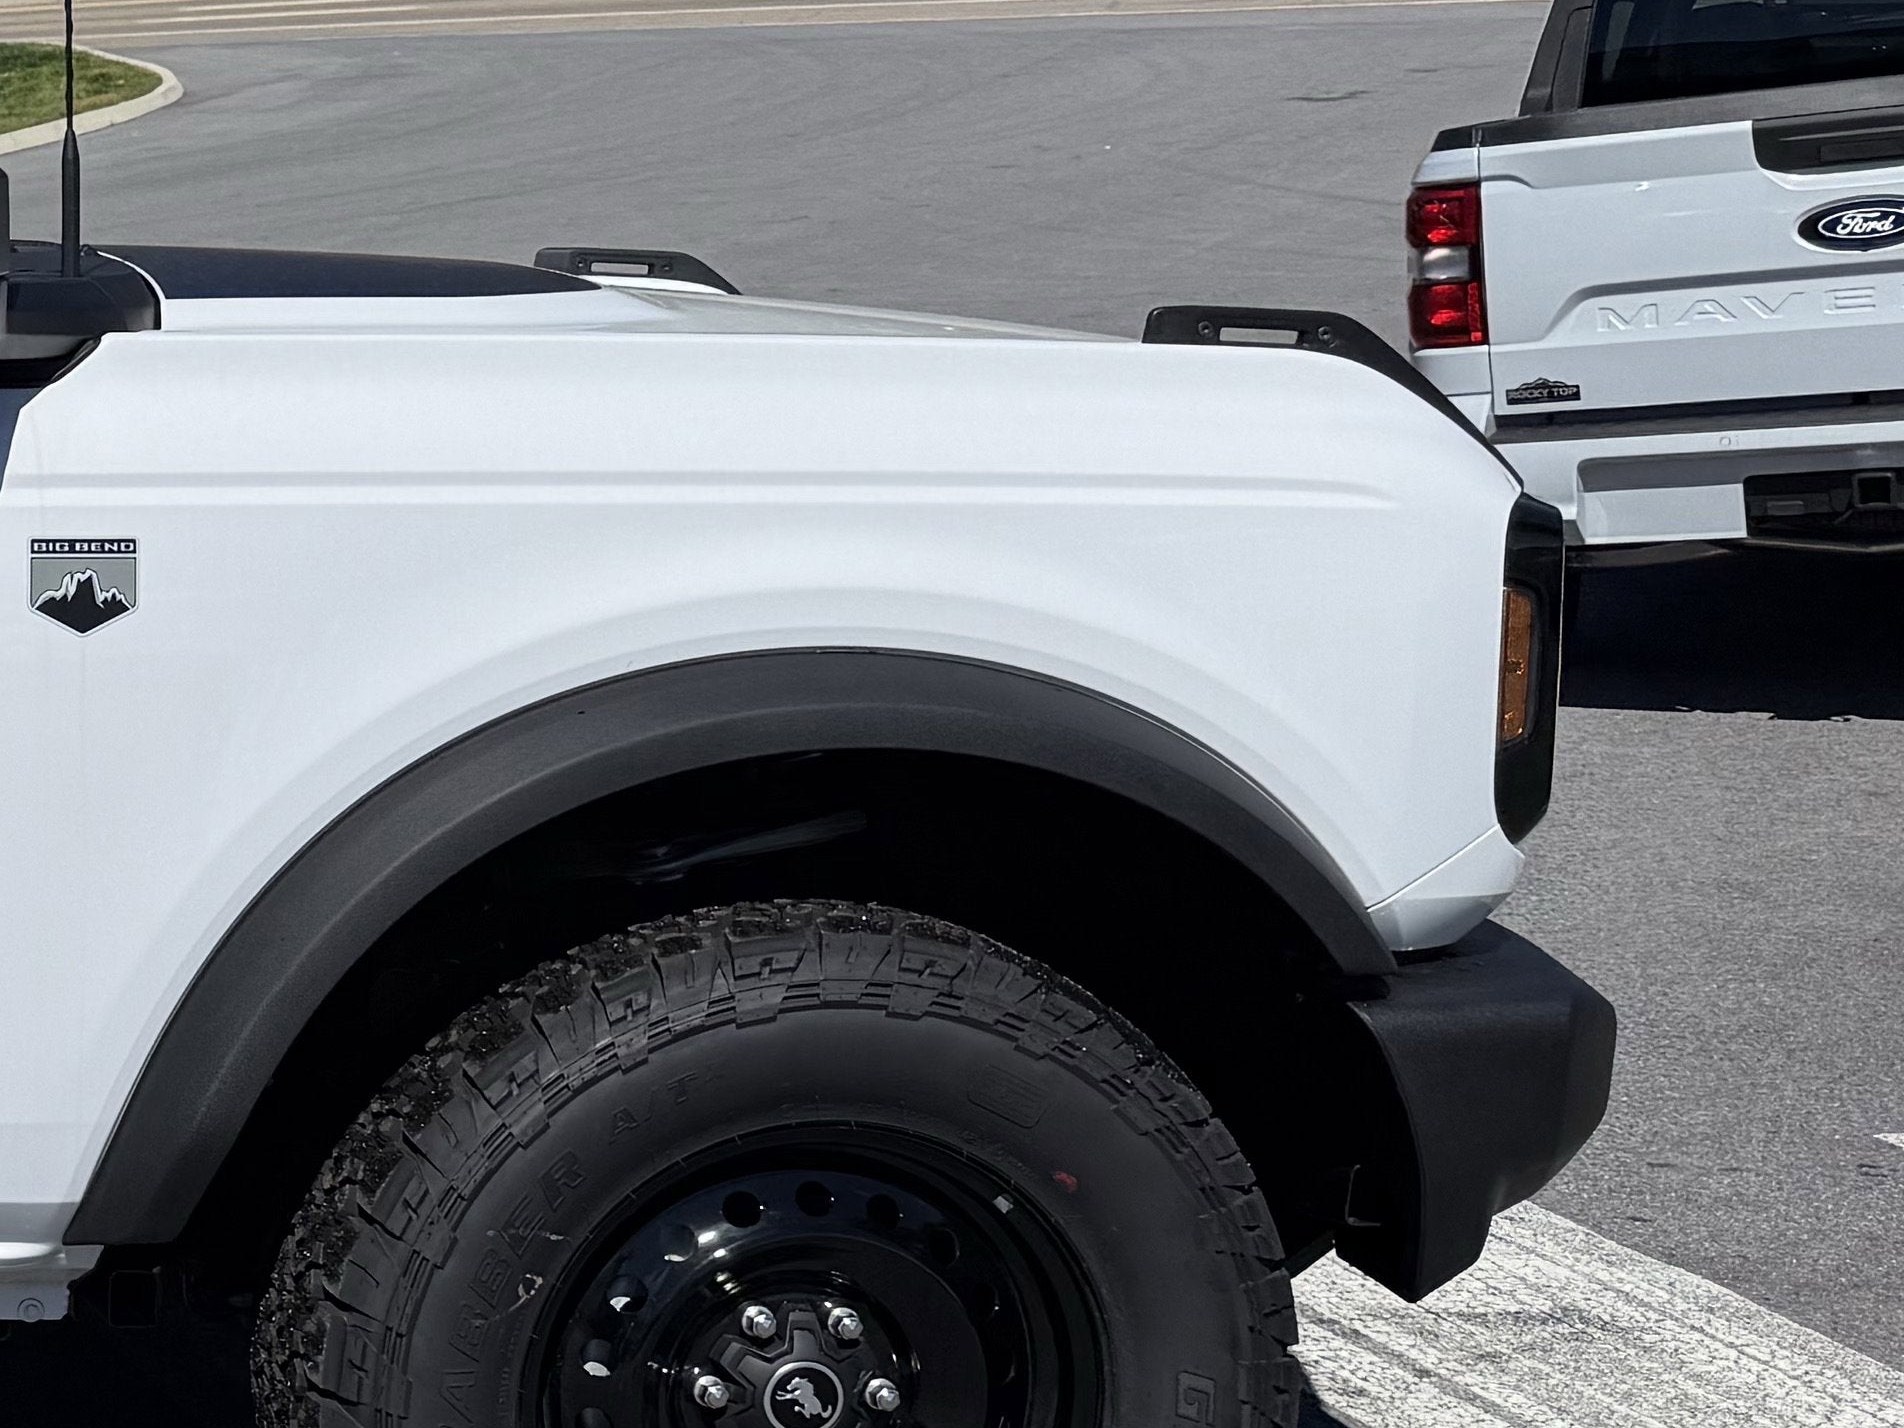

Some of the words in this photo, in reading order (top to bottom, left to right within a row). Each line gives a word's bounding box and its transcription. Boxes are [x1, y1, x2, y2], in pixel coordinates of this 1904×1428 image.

[1836, 212, 1896, 236] Ford
[1596, 285, 1904, 333] MAVE
[1551, 386, 1578, 397] TOP
[33, 541, 71, 552] BIG
[75, 541, 135, 552] BEND
